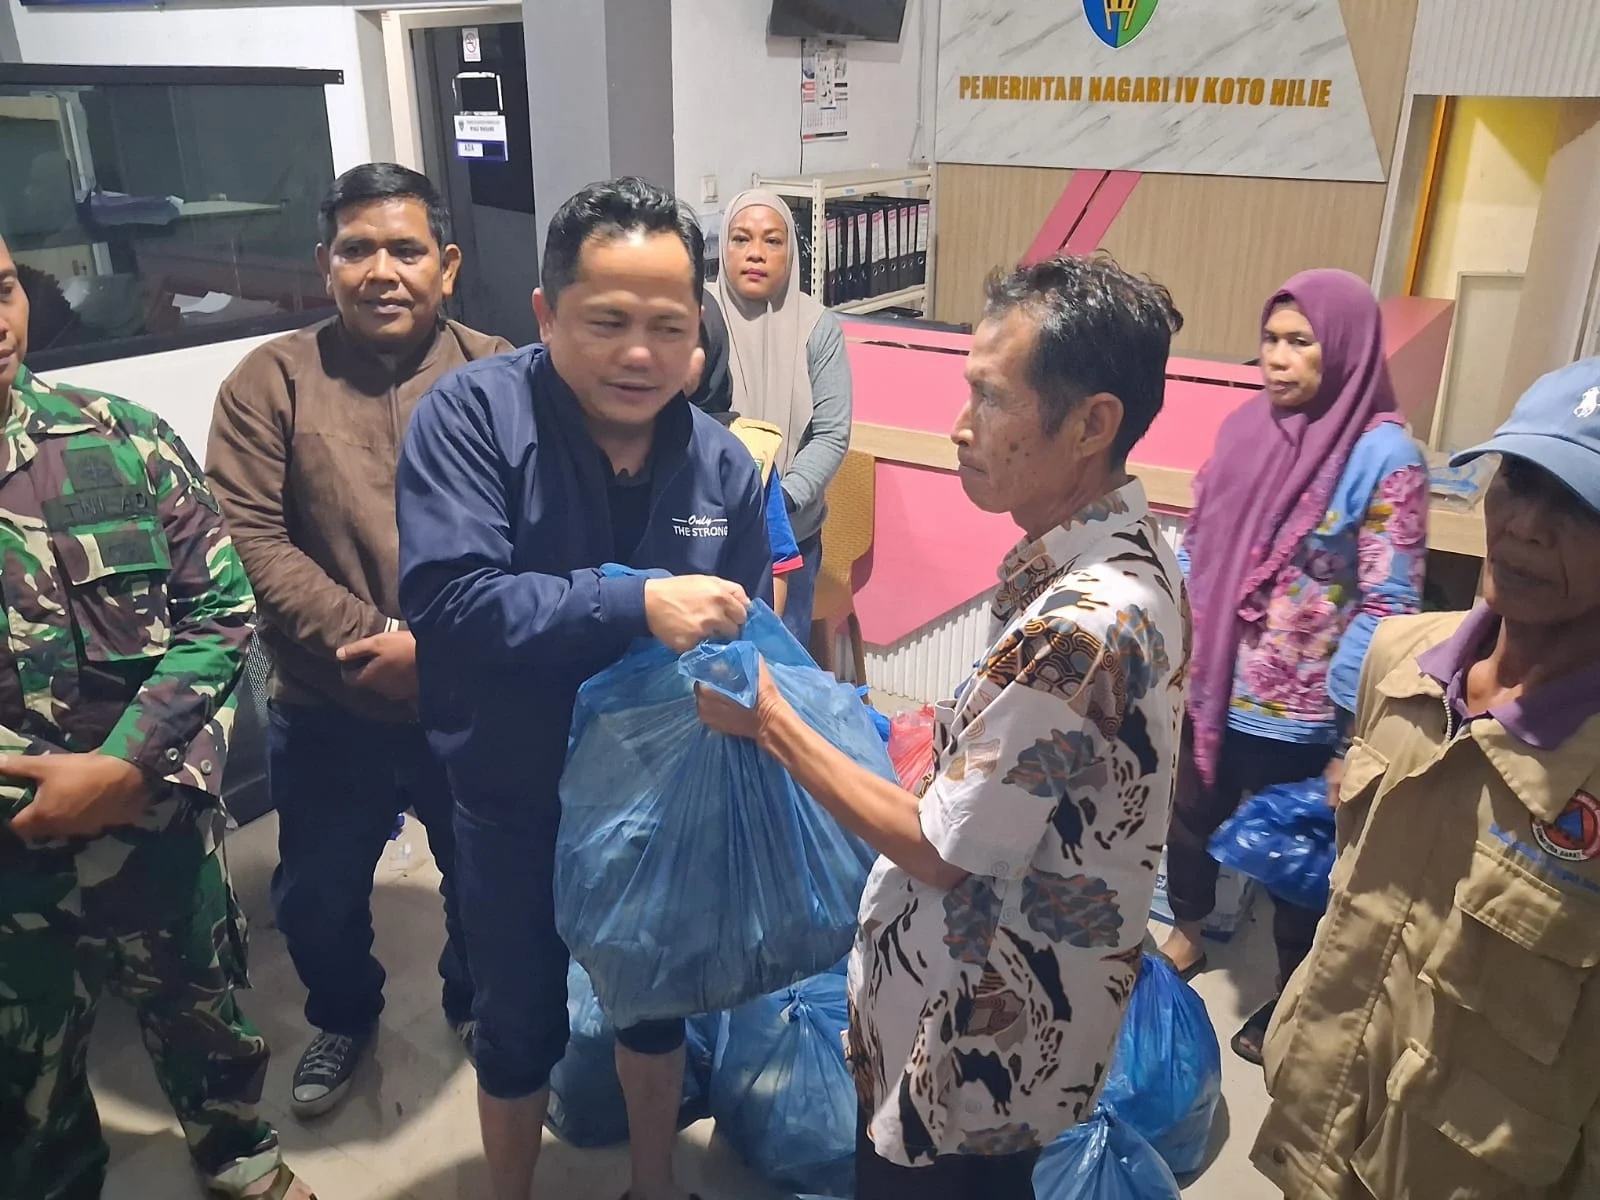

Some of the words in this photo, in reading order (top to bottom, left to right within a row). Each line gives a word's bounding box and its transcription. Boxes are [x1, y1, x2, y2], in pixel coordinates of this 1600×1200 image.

[959, 75, 1083, 101] PEMERINTAH
[1088, 76, 1170, 103] NAGARI
[1174, 76, 1199, 103] IV
[1202, 76, 1266, 105] KOTO
[1269, 78, 1332, 107] HILIE
[688, 515, 712, 527] Only
[673, 525, 691, 537] THE
[692, 526, 728, 537] STRONG
